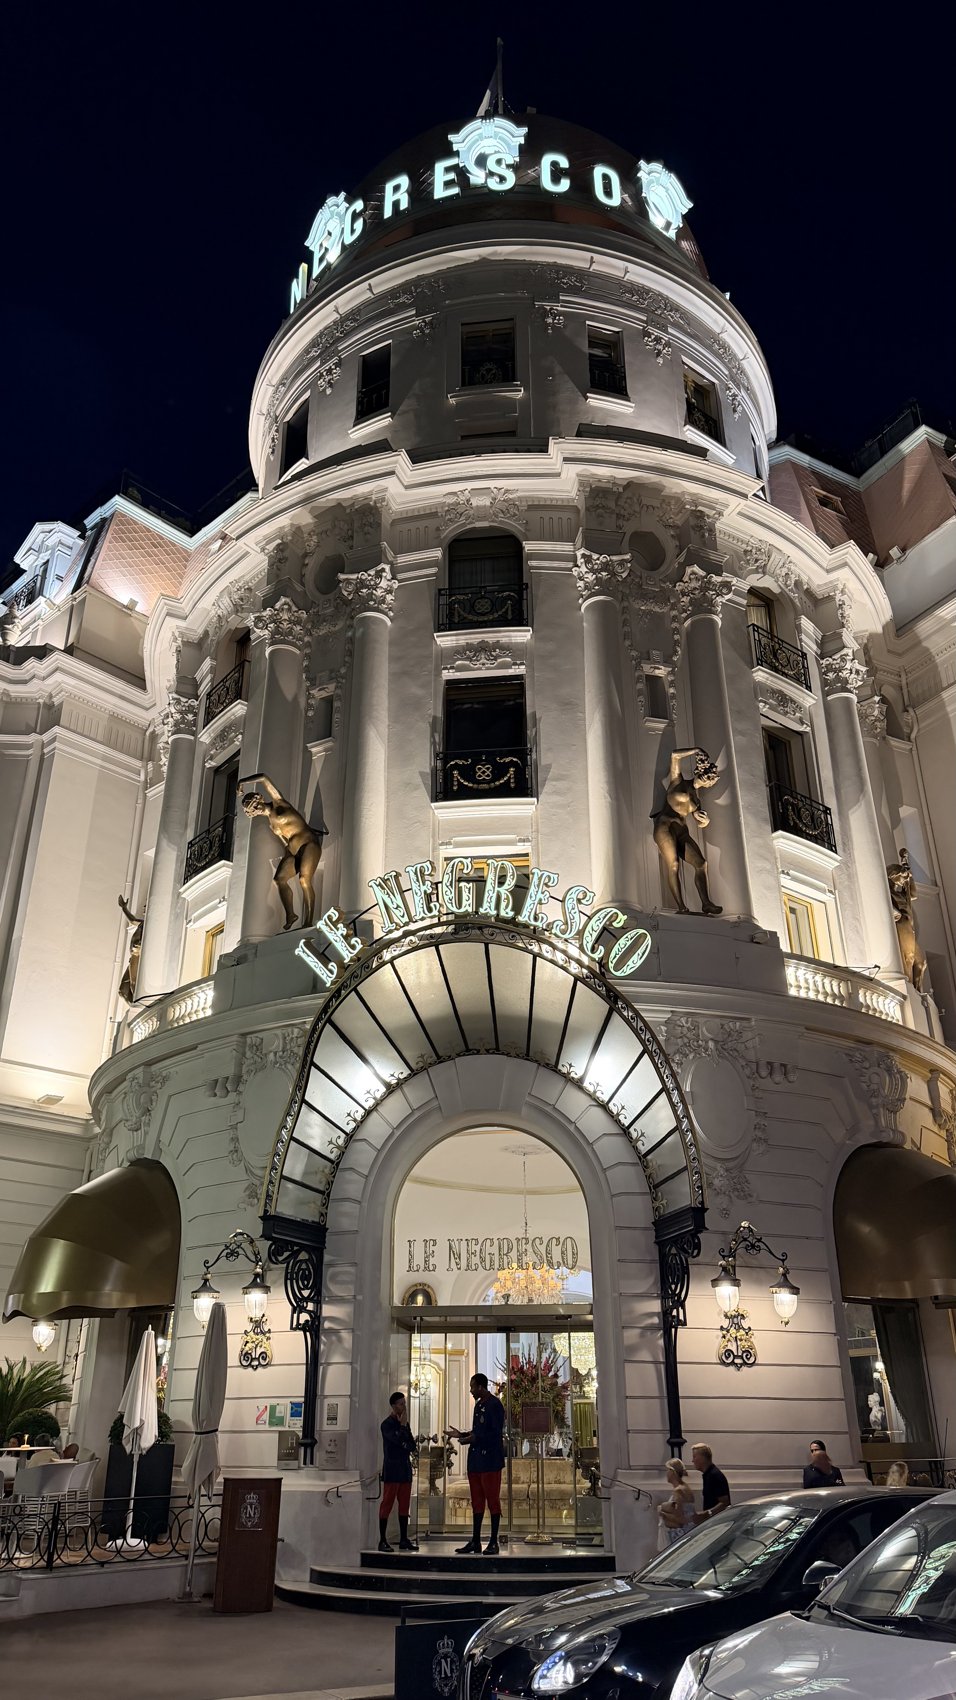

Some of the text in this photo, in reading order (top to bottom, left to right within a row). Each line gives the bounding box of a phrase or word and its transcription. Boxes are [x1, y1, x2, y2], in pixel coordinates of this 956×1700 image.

[290, 152, 621, 314] NEGRESCO
[295, 857, 653, 987] LE NEGRESCO
[406, 1236, 579, 1273] LE NEGRESCO
[288, 1436, 296, 1447] H
[246, 1504, 256, 1518] N
[441, 1658, 452, 1678] N
